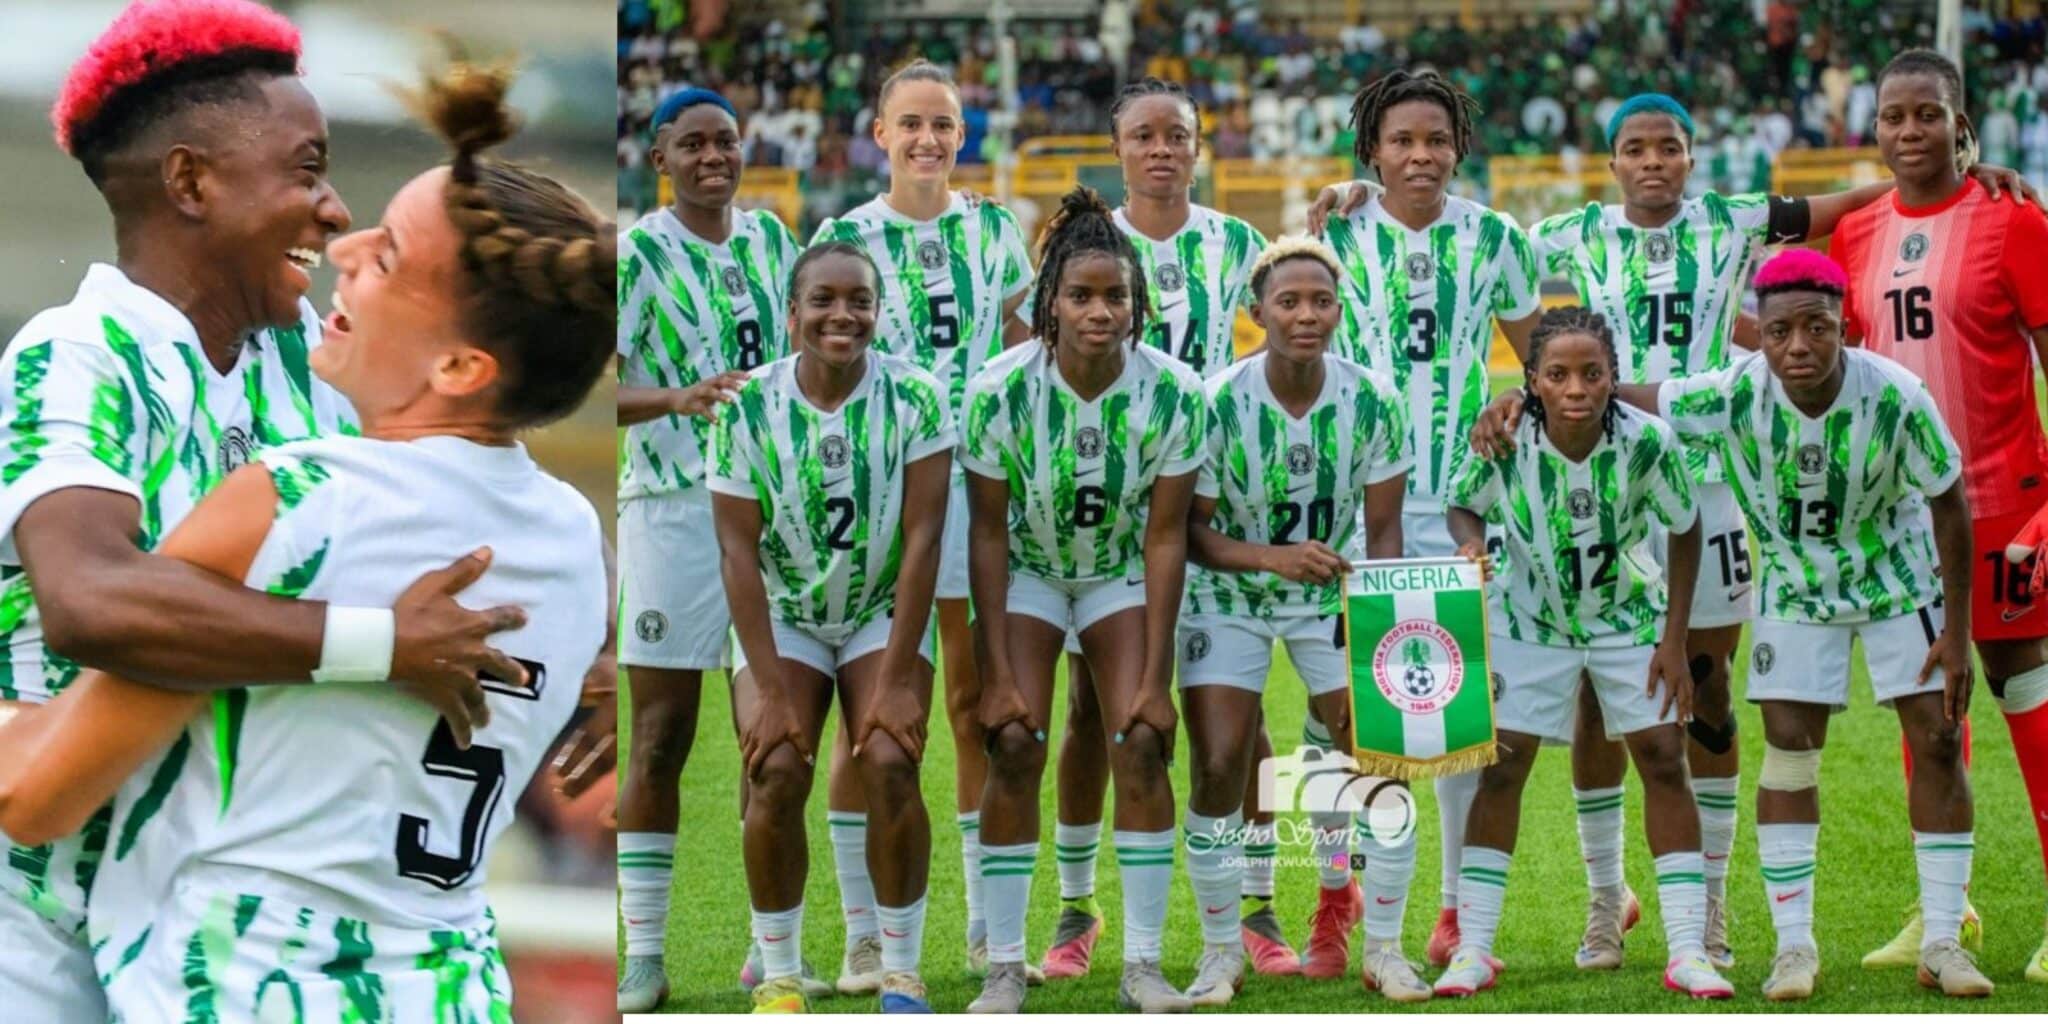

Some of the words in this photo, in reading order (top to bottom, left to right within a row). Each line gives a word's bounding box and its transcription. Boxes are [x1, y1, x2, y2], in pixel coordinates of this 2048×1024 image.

[928, 294, 960, 348] 5
[1407, 308, 1437, 362] 3
[1638, 293, 1693, 346] 15
[1884, 286, 1934, 342] 16
[736, 319, 764, 371] 8
[1151, 318, 1206, 373] 14
[825, 497, 855, 550] 2
[1074, 485, 1106, 528] 6
[1269, 495, 1334, 546] 20
[1783, 496, 1837, 541] 13
[1363, 567, 1463, 592] NIGERIA
[1559, 543, 1619, 592] 12
[1708, 531, 1752, 587] 15
[1984, 549, 2036, 605] 16
[1382, 623, 1432, 648] FOOTBALL
[1435, 628, 1461, 693] FEDERATION
[1375, 652, 1392, 696] NIGERIA
[1410, 701, 1435, 710] 1945
[395, 656, 546, 891] 5
